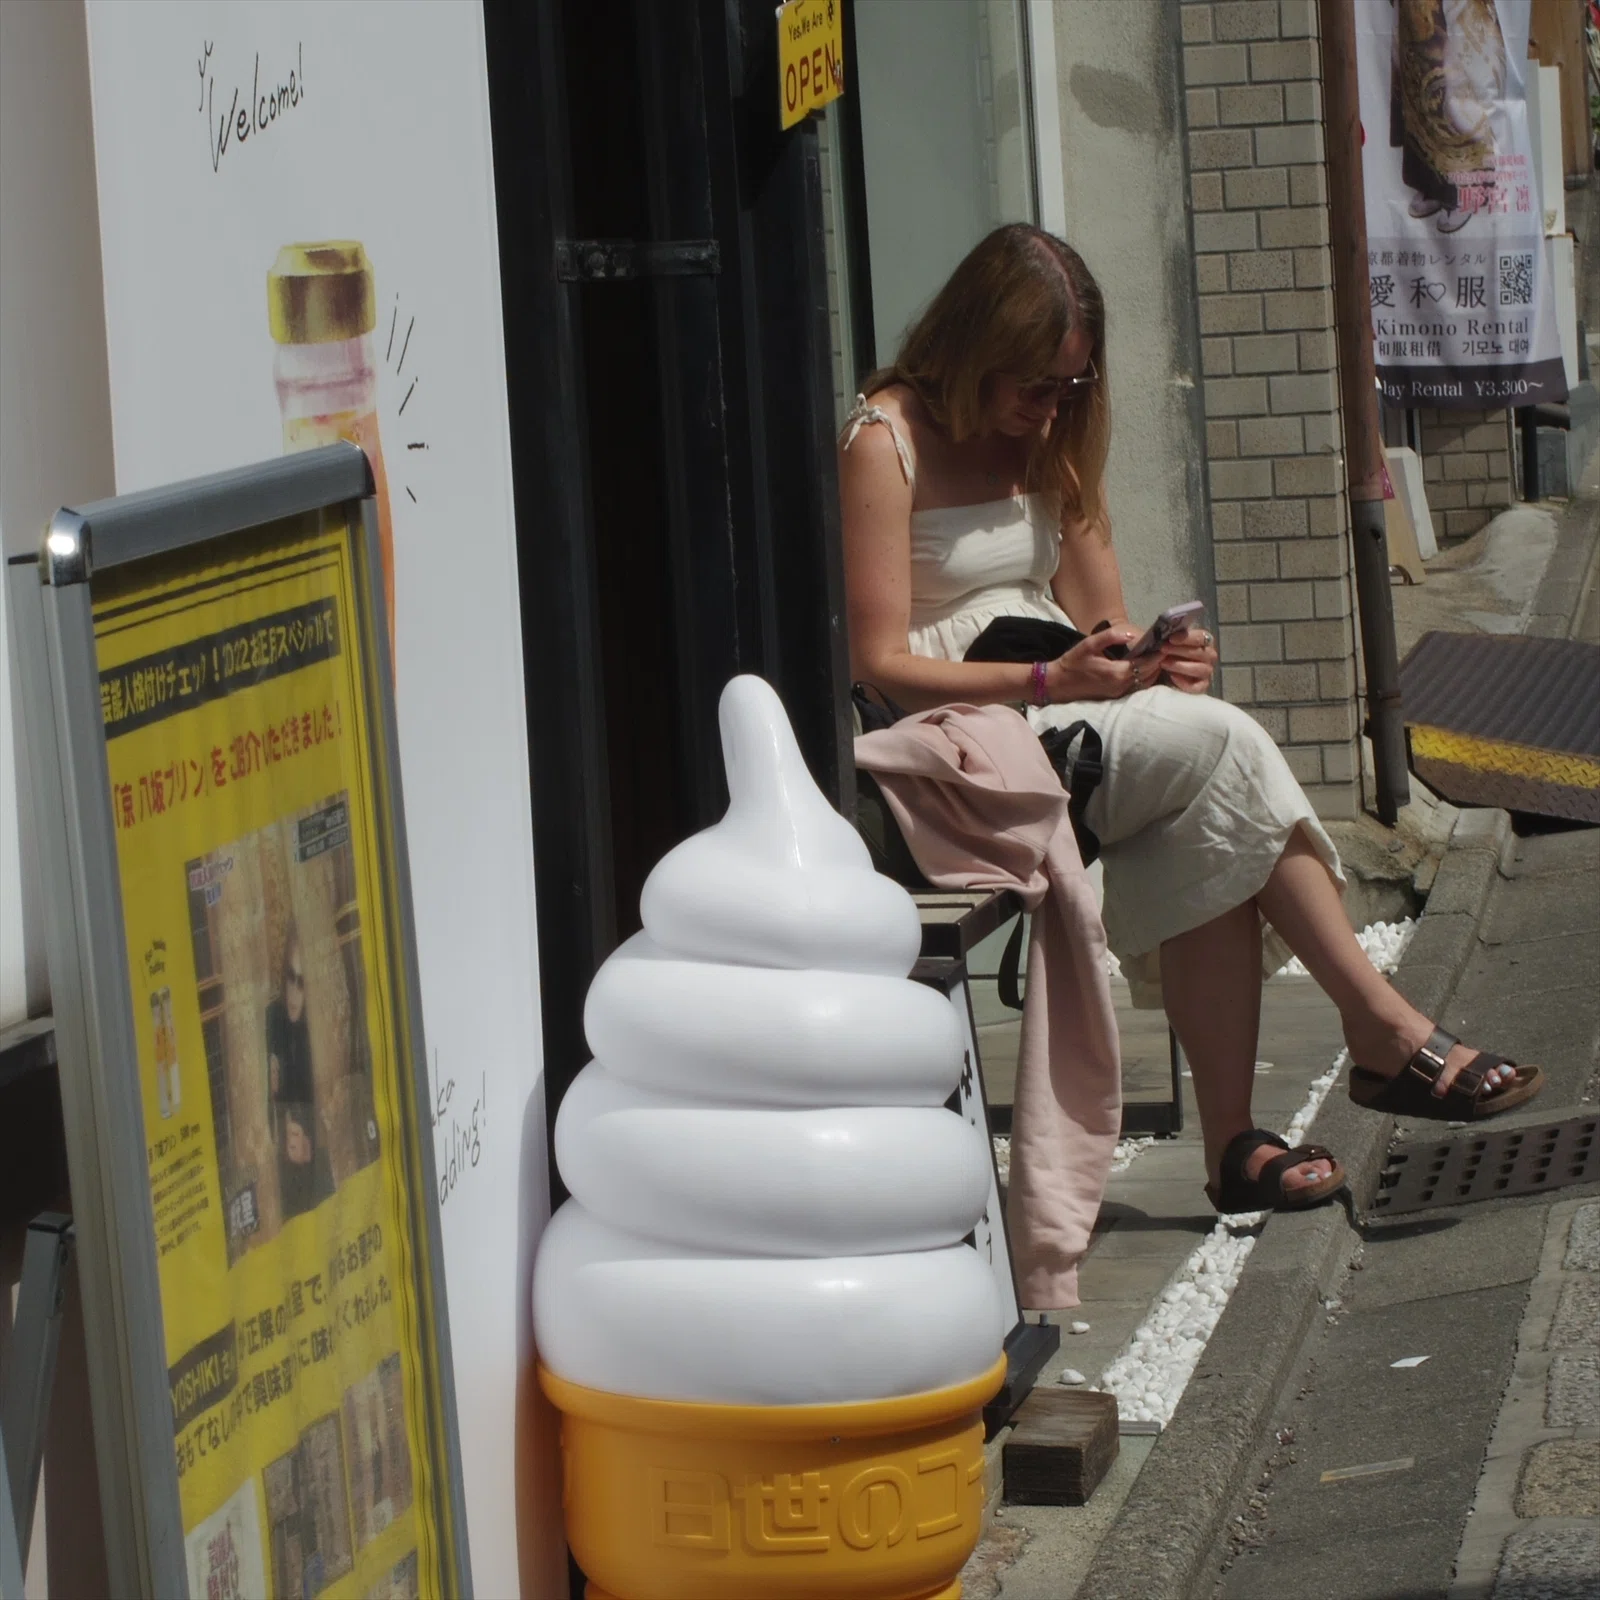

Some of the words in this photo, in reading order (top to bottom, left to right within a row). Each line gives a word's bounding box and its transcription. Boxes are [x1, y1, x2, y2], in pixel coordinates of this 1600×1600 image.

[785, 39, 836, 112] OPEN
[208, 40, 304, 173] Welcome!
[1368, 251, 1488, 267] 京都着物レンタル
[1377, 318, 1457, 336] Kimono
[1467, 317, 1529, 336] Rental
[1378, 340, 1442, 357] 和服租借
[1462, 340, 1504, 356] 기모노
[1508, 338, 1530, 355] 대여
[1411, 381, 1463, 398] Rental
